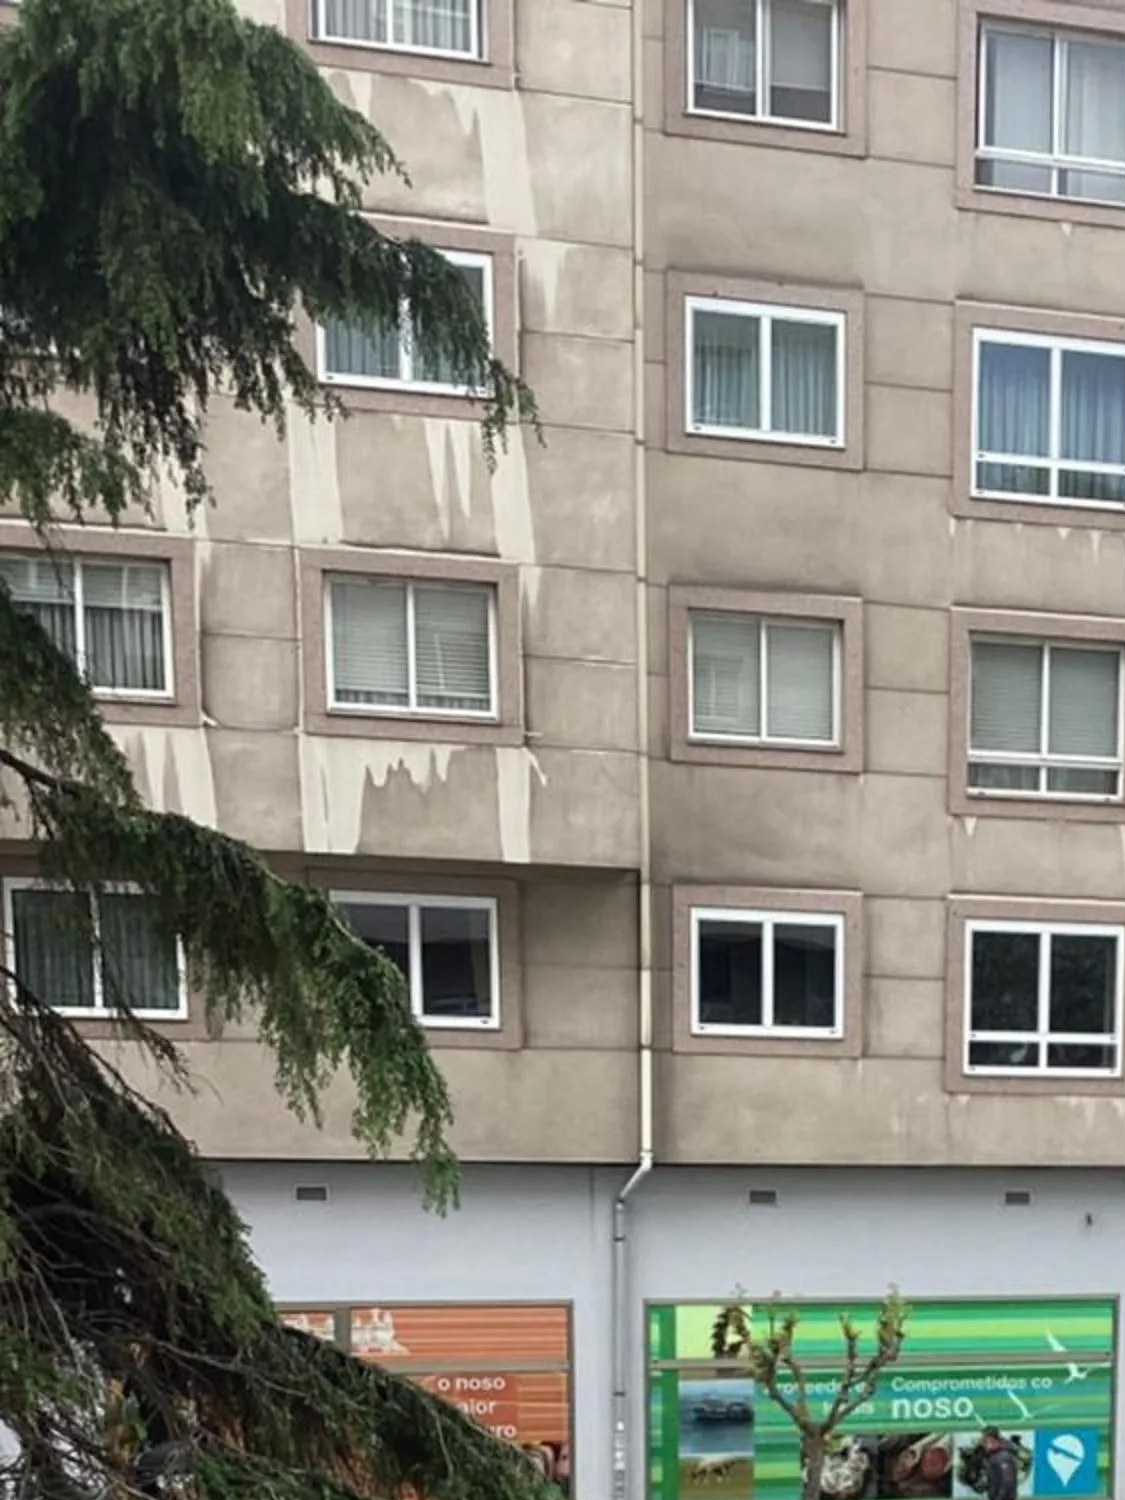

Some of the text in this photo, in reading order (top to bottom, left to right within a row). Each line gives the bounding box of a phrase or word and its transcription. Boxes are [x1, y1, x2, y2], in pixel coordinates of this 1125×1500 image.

[438, 1377, 506, 1391] o noso
[1031, 1376, 1053, 1389] co
[891, 1397, 974, 1420] noso
